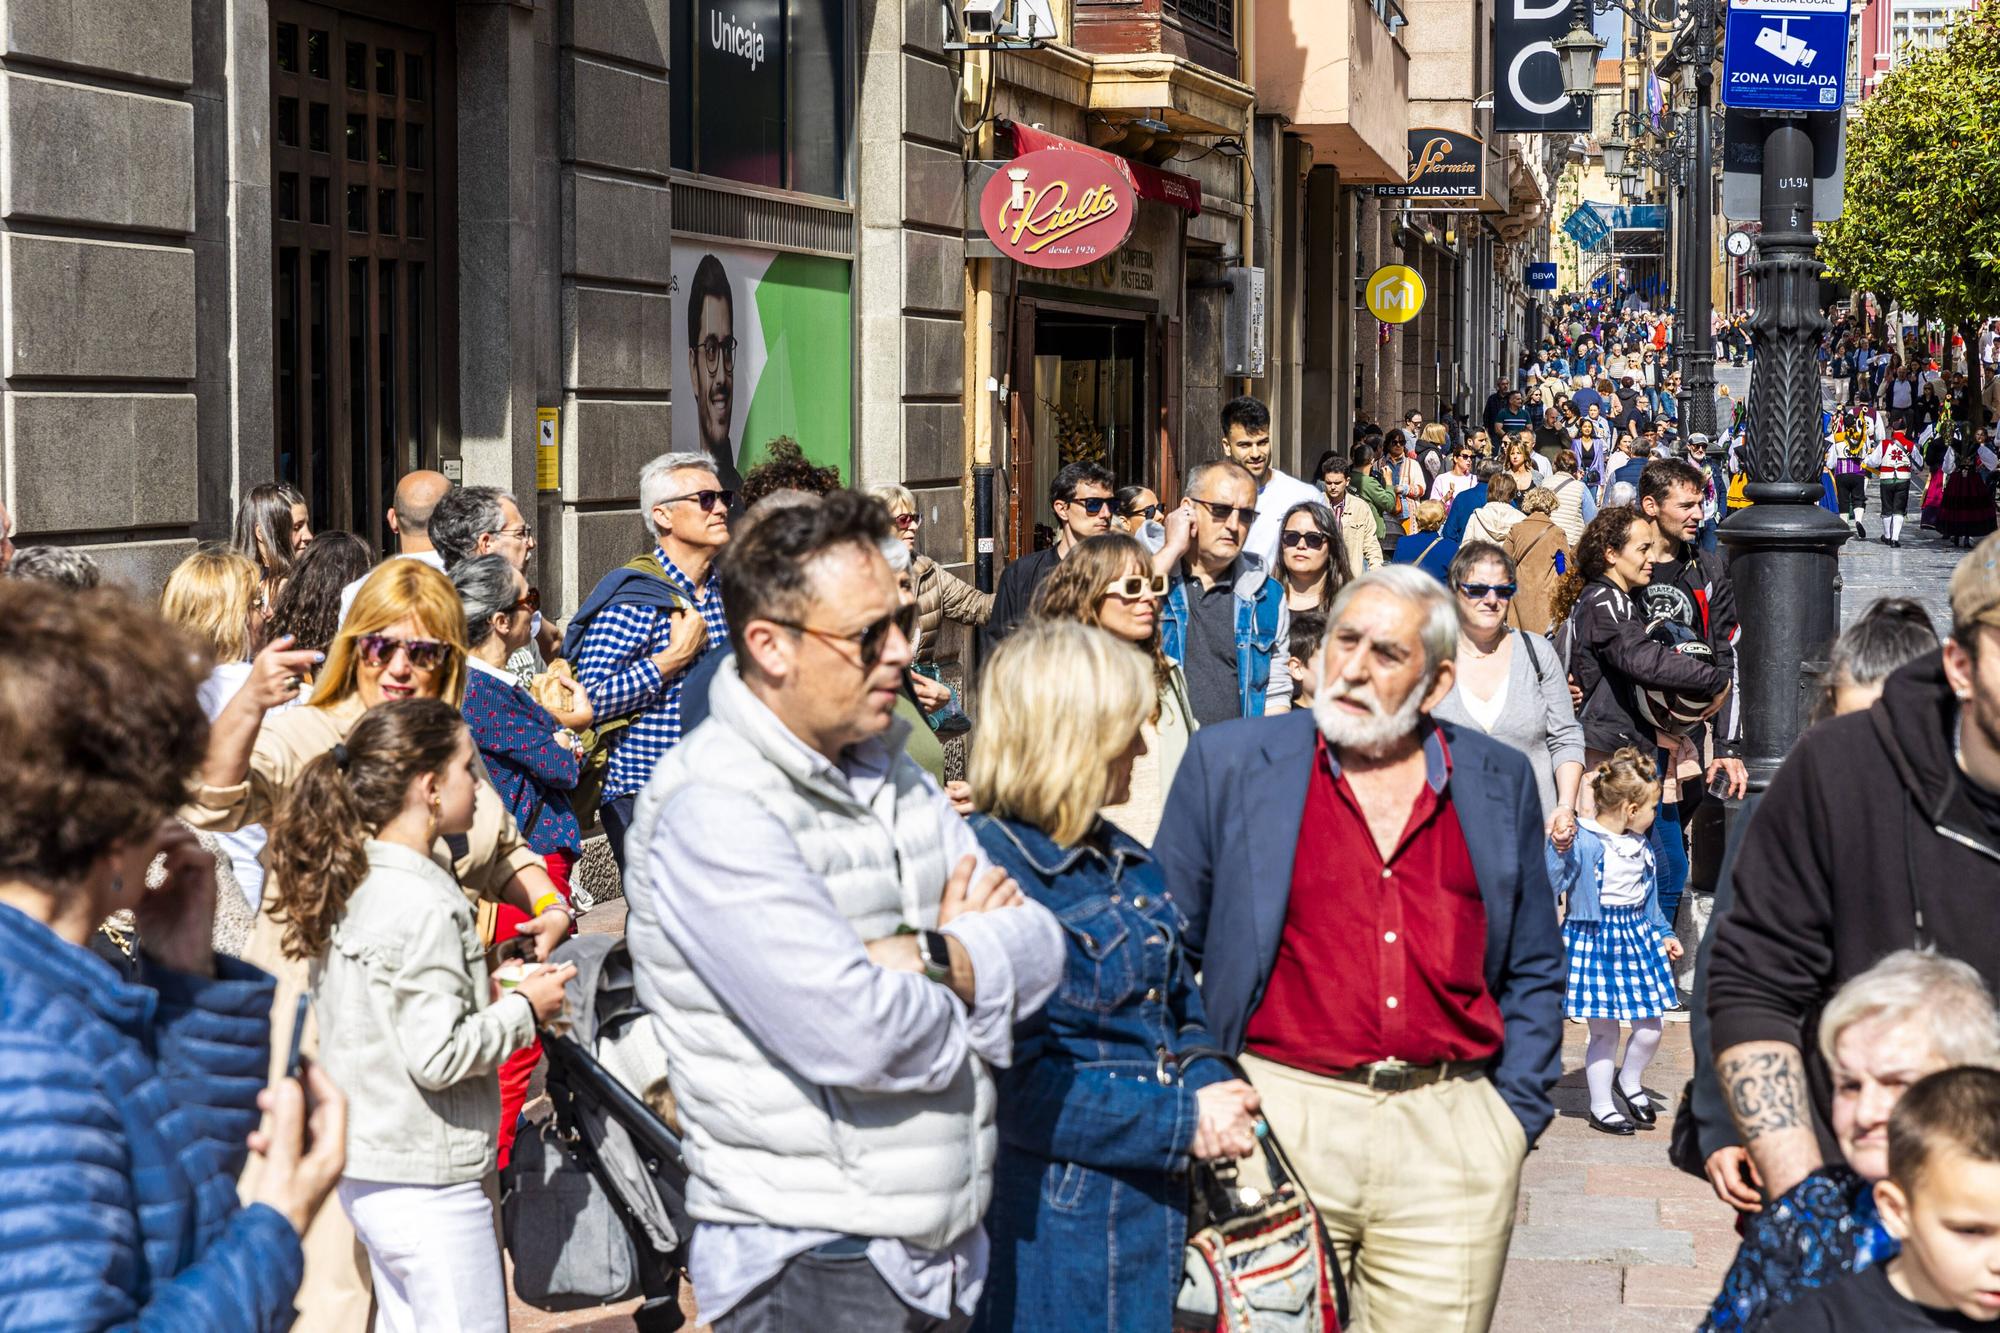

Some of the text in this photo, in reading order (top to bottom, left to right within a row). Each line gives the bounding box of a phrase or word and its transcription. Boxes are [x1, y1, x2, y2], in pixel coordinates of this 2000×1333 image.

[711, 9, 764, 71] Unicaja
[1731, 72, 1838, 85] ZONA VIGILADA
[1379, 186, 1476, 195] RESTAURANTE
[999, 180, 1119, 245] Rialto
[1790, 216, 1798, 227] 5
[1048, 245, 1096, 254] desde 1926
[1532, 272, 1555, 280] BBVA
